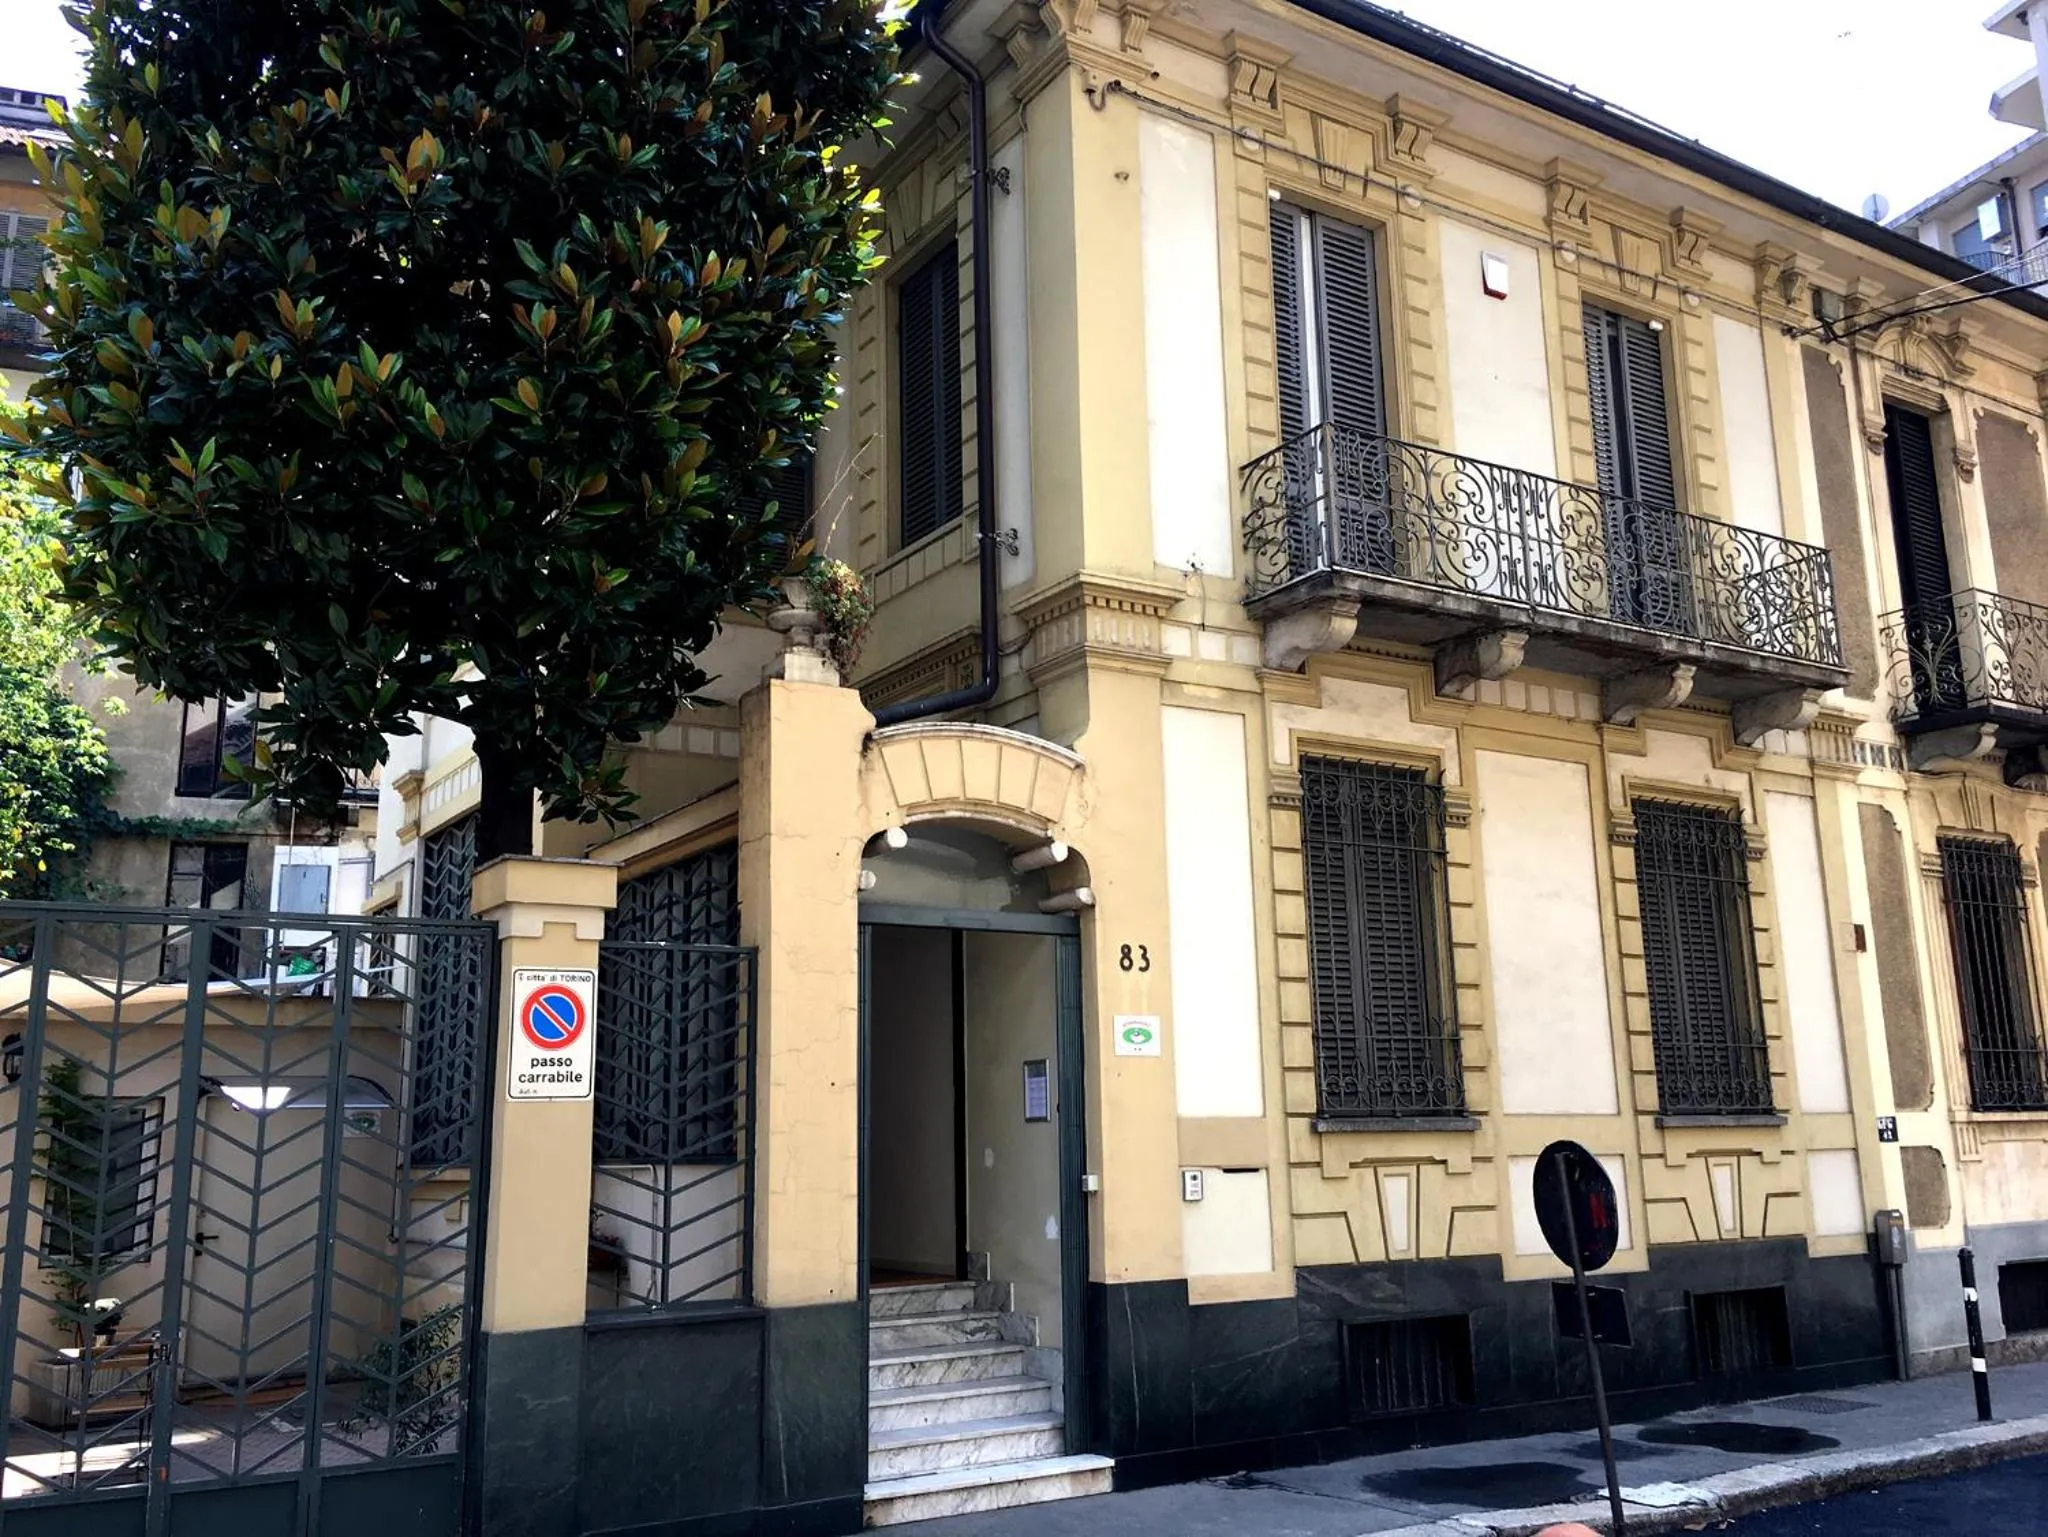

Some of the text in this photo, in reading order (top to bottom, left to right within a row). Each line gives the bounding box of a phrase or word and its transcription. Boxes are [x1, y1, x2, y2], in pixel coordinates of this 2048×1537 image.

[1119, 943, 1151, 973] 83
[560, 974, 592, 983] TORINO
[530, 1057, 573, 1069] passo
[518, 1071, 583, 1084] carrabile
